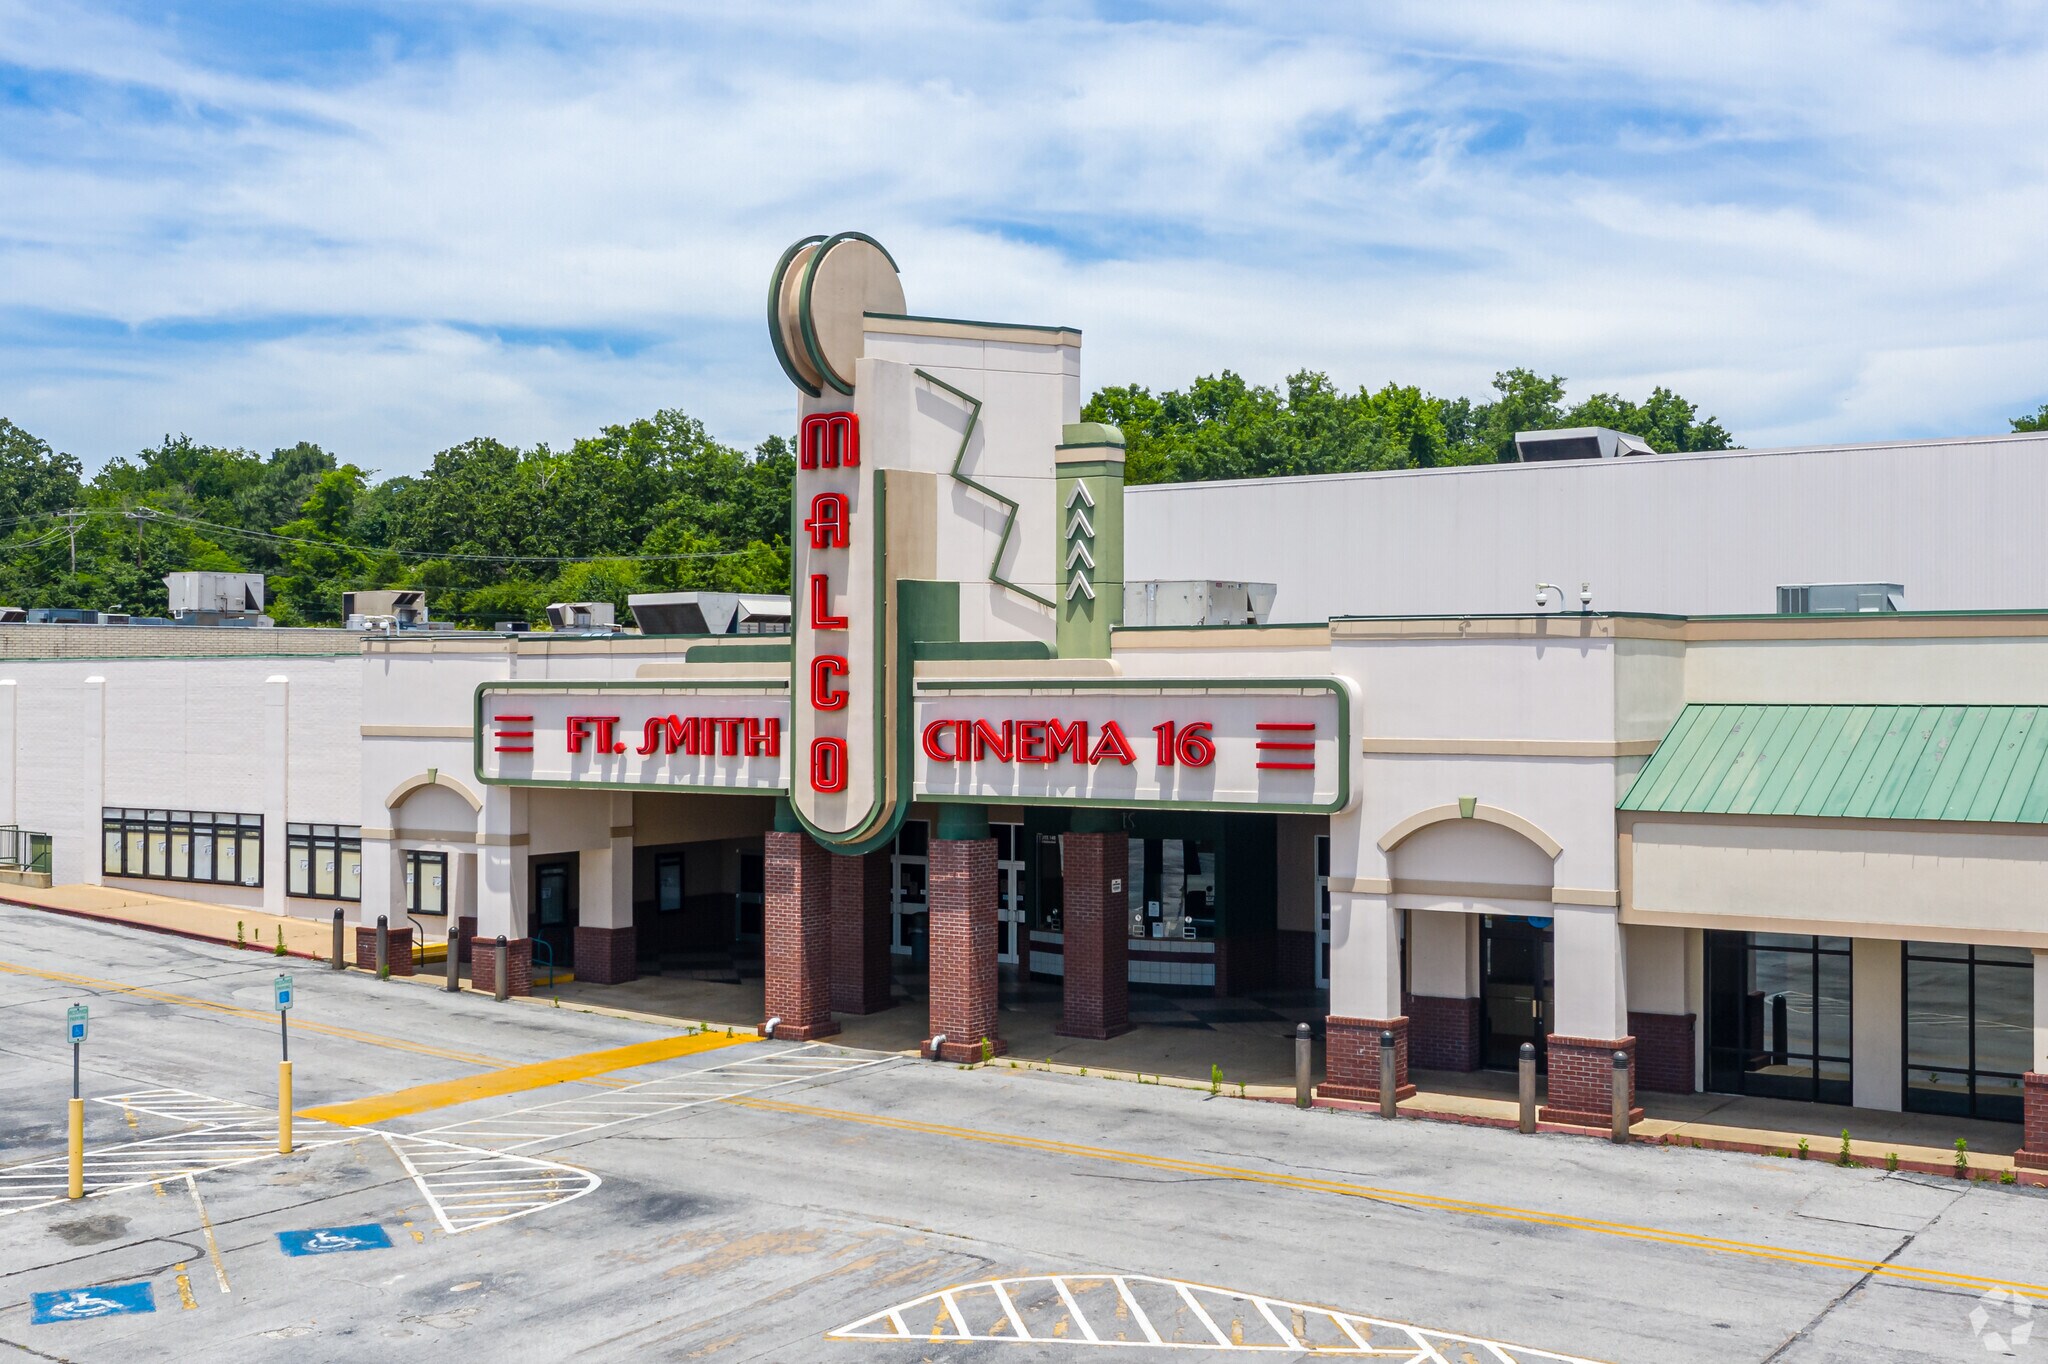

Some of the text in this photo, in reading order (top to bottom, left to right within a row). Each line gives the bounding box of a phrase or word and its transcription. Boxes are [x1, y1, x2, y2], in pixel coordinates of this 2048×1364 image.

[801, 411, 860, 793] MALCO
[567, 714, 780, 757] FT. SMITH
[922, 718, 1216, 768] CINEMA 16
